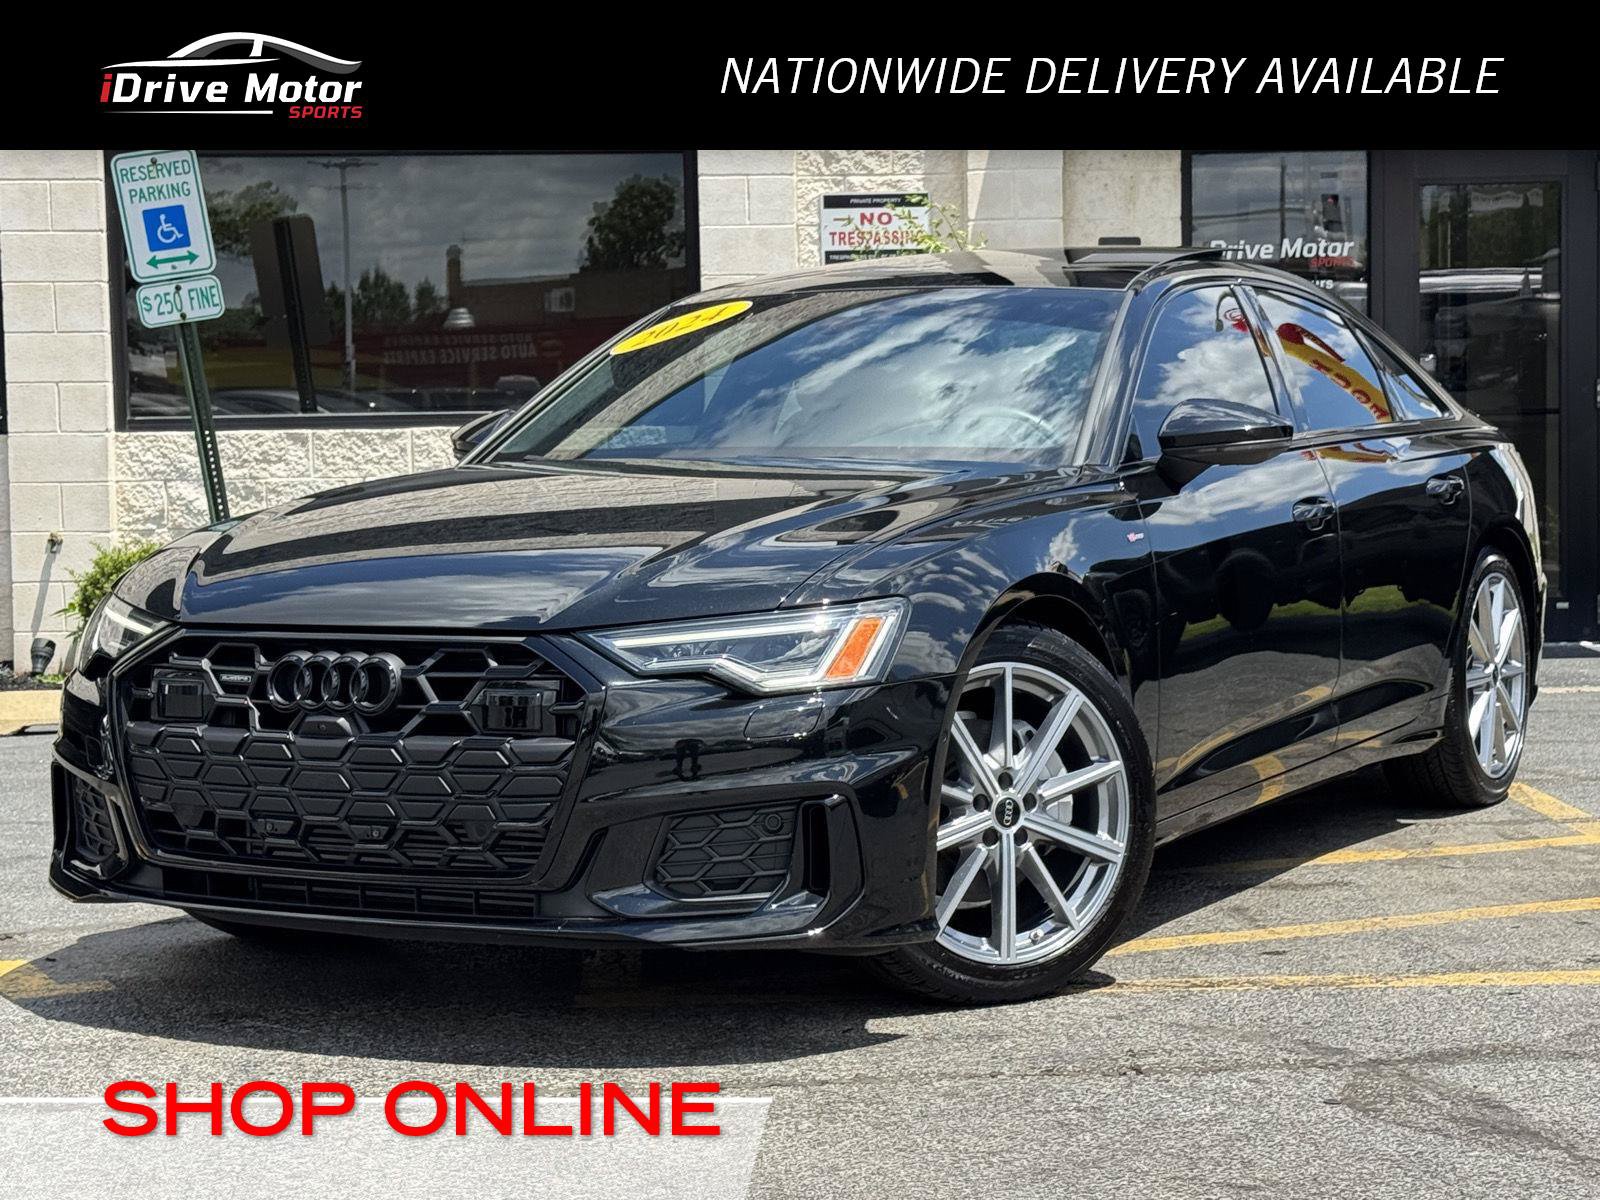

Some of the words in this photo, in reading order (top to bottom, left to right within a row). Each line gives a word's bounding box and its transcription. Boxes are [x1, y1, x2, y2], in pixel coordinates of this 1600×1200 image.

[119, 159, 191, 184] RESERVED
[129, 181, 191, 204] PARKING
[859, 212, 893, 226] NO
[1280, 238, 1354, 258] Motor
[188, 285, 219, 310] FINE
